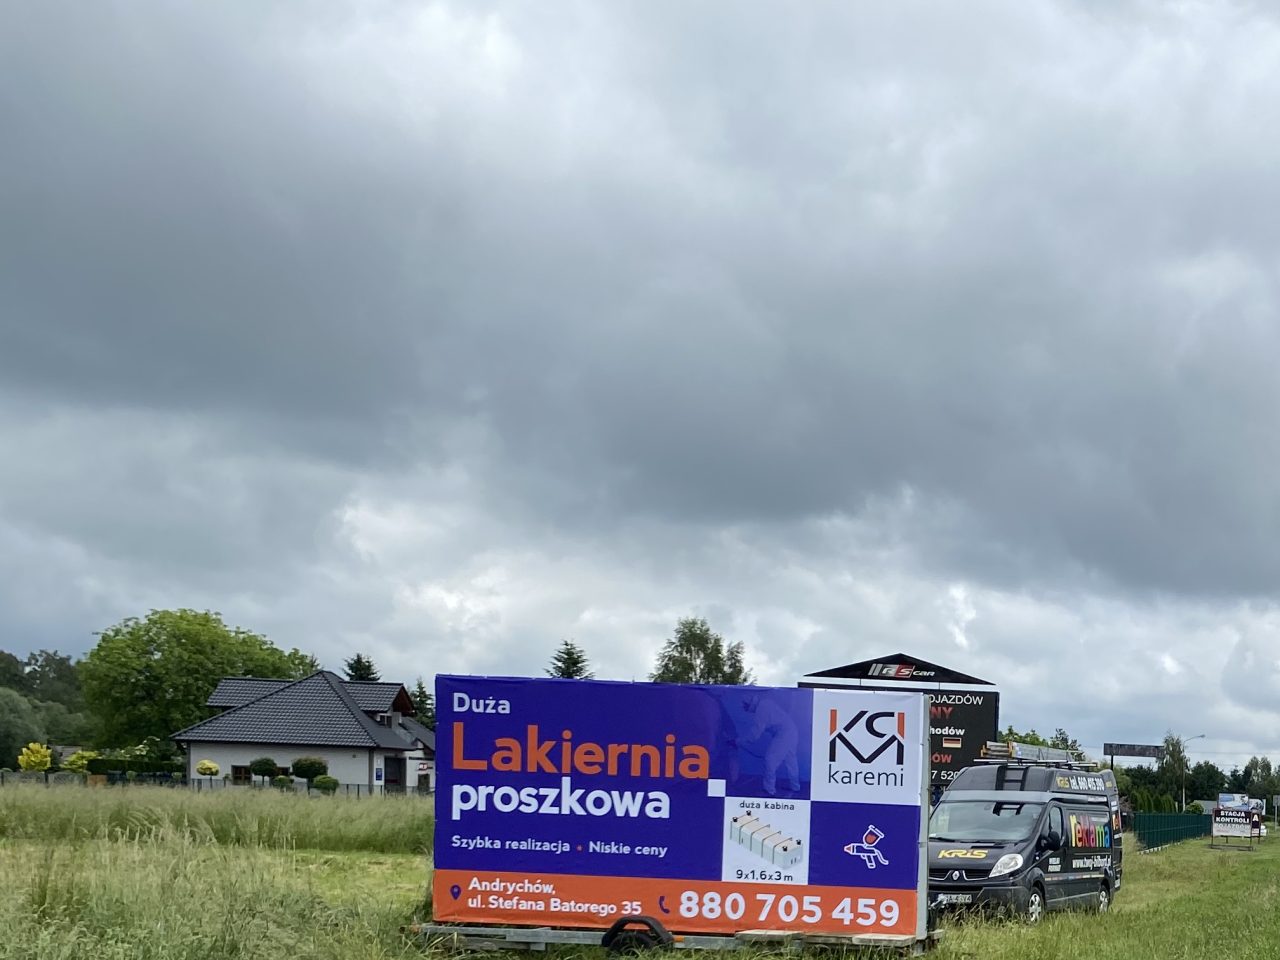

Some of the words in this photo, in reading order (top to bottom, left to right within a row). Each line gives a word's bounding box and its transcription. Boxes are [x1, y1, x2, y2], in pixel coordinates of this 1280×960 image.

[453, 692, 511, 714] Duża
[930, 694, 983, 705] OJAZDÓW
[930, 706, 953, 719] NY
[930, 726, 965, 736] hodów
[453, 722, 710, 779] Lakiernia
[827, 764, 904, 787] karemi
[452, 776, 671, 821] proszkowa
[739, 800, 761, 809] duża
[764, 801, 795, 811] kabina
[1069, 814, 1111, 848] reklama
[451, 835, 501, 849] Szybka
[505, 839, 570, 854] realizacja
[589, 841, 631, 854] Niskie
[634, 846, 668, 858] ceny
[468, 877, 556, 895] Andrychów,
[468, 897, 486, 908] ul.
[488, 895, 545, 911] Stefana
[550, 898, 617, 917] Batorego
[621, 901, 642, 915] 35
[679, 891, 745, 920] 880
[756, 894, 823, 924] 705
[832, 897, 900, 927] 459
